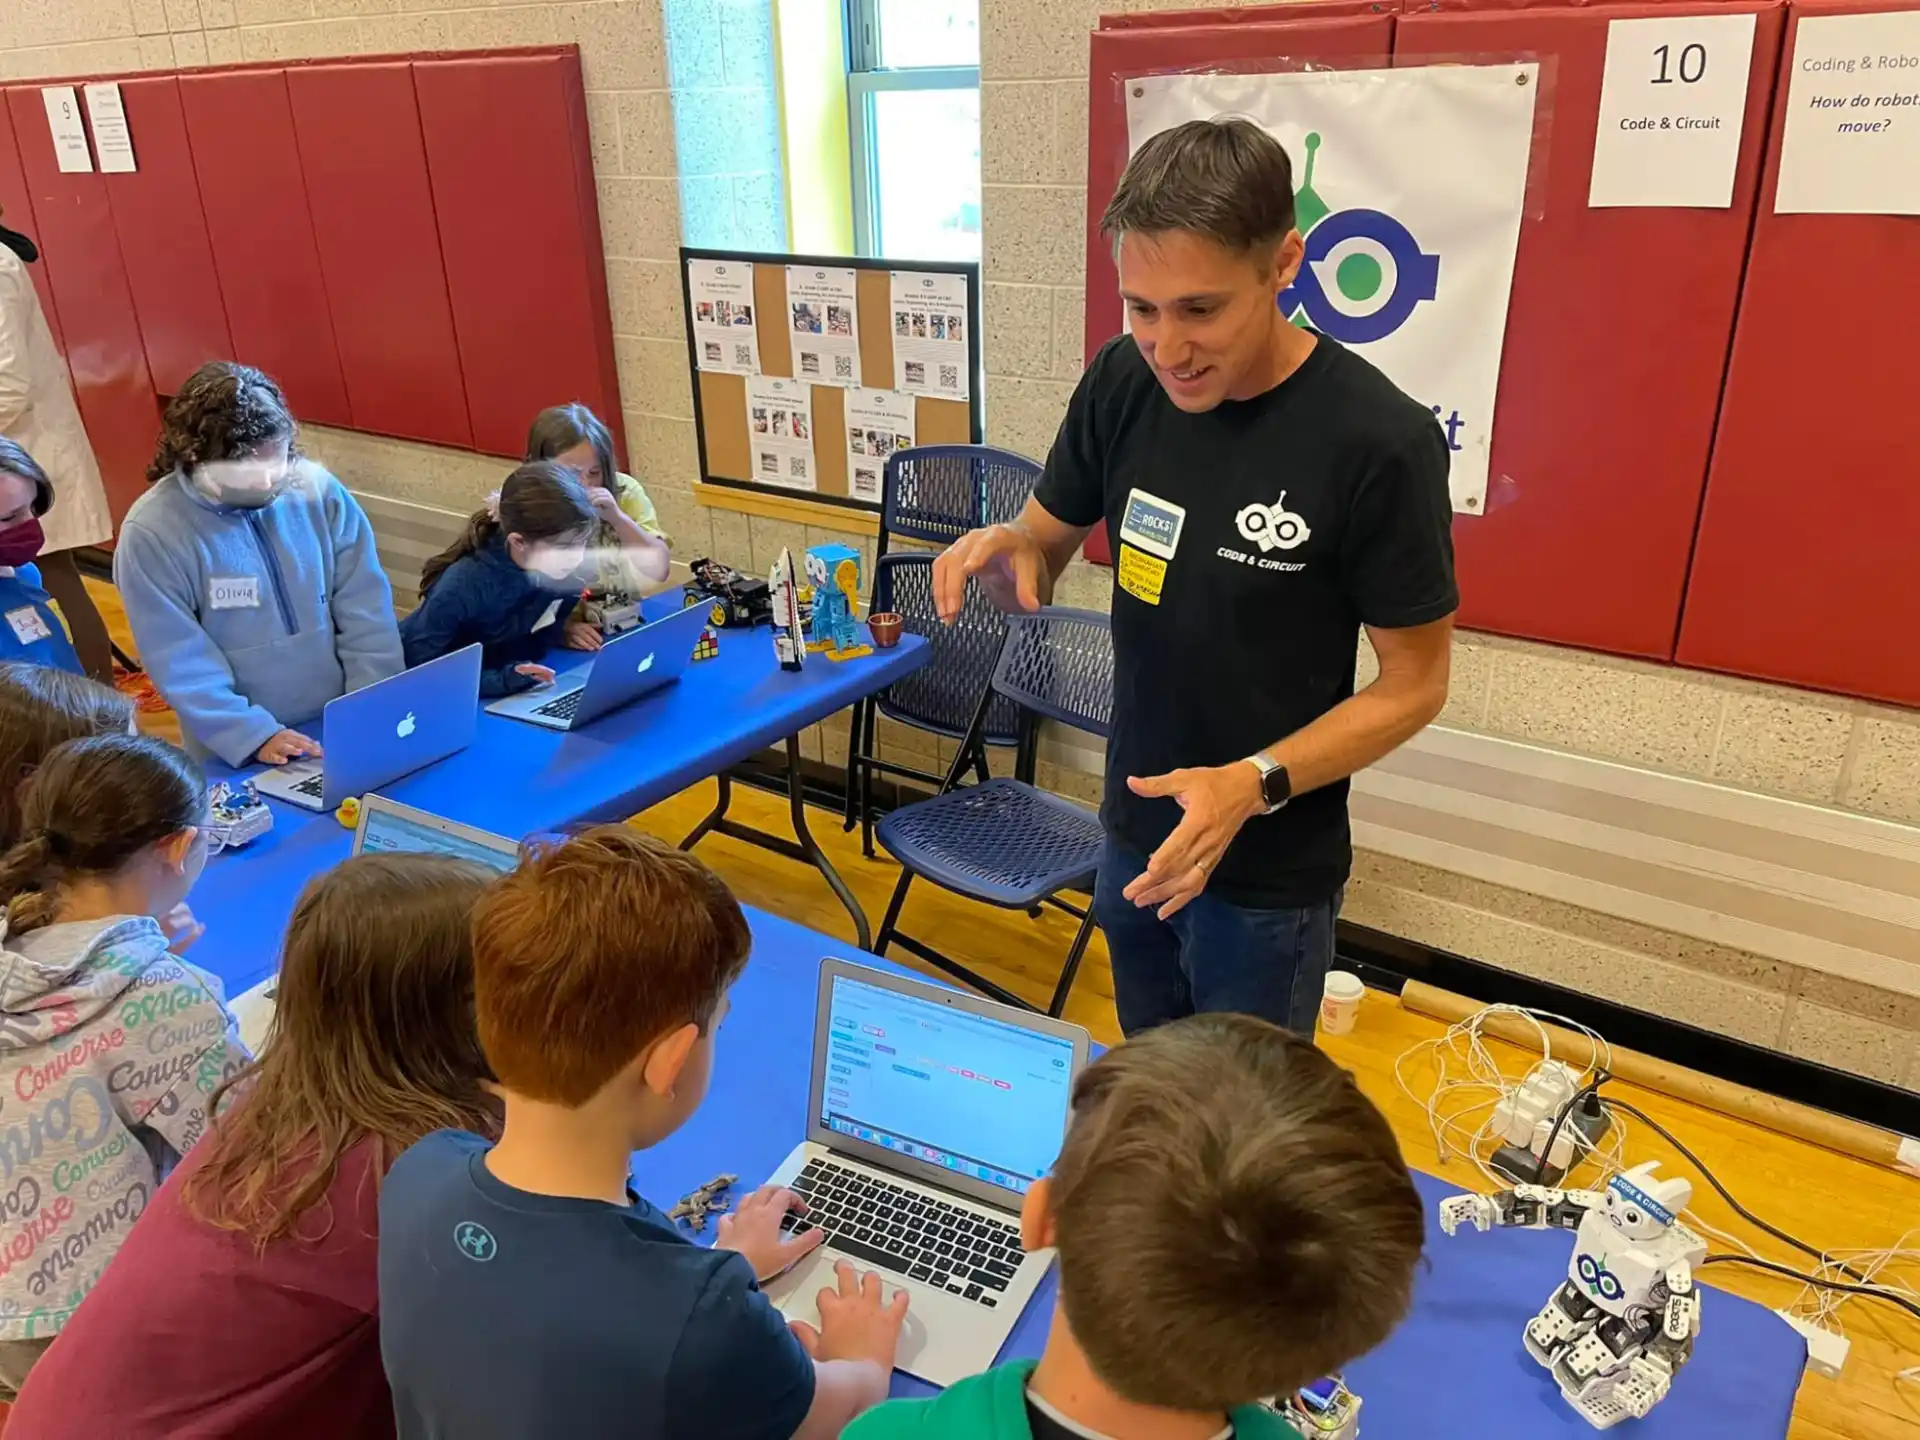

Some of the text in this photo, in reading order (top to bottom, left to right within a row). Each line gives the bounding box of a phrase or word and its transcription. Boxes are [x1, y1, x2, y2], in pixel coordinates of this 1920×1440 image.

[1650, 43, 1707, 84] 10
[1802, 53, 1919, 73] Coding & Robo
[62, 100, 71, 120] 9
[1809, 95, 1847, 108] How
[1850, 93, 1870, 108] do
[1619, 116, 1721, 131] Code & Circuit
[1837, 118, 1892, 133] move?
[1216, 546, 1307, 572] CODE & CIRCUIT
[215, 587, 253, 600] Olivia
[131, 966, 184, 990] verse
[148, 1015, 223, 1055] Conver
[14, 1027, 125, 1102] Converse
